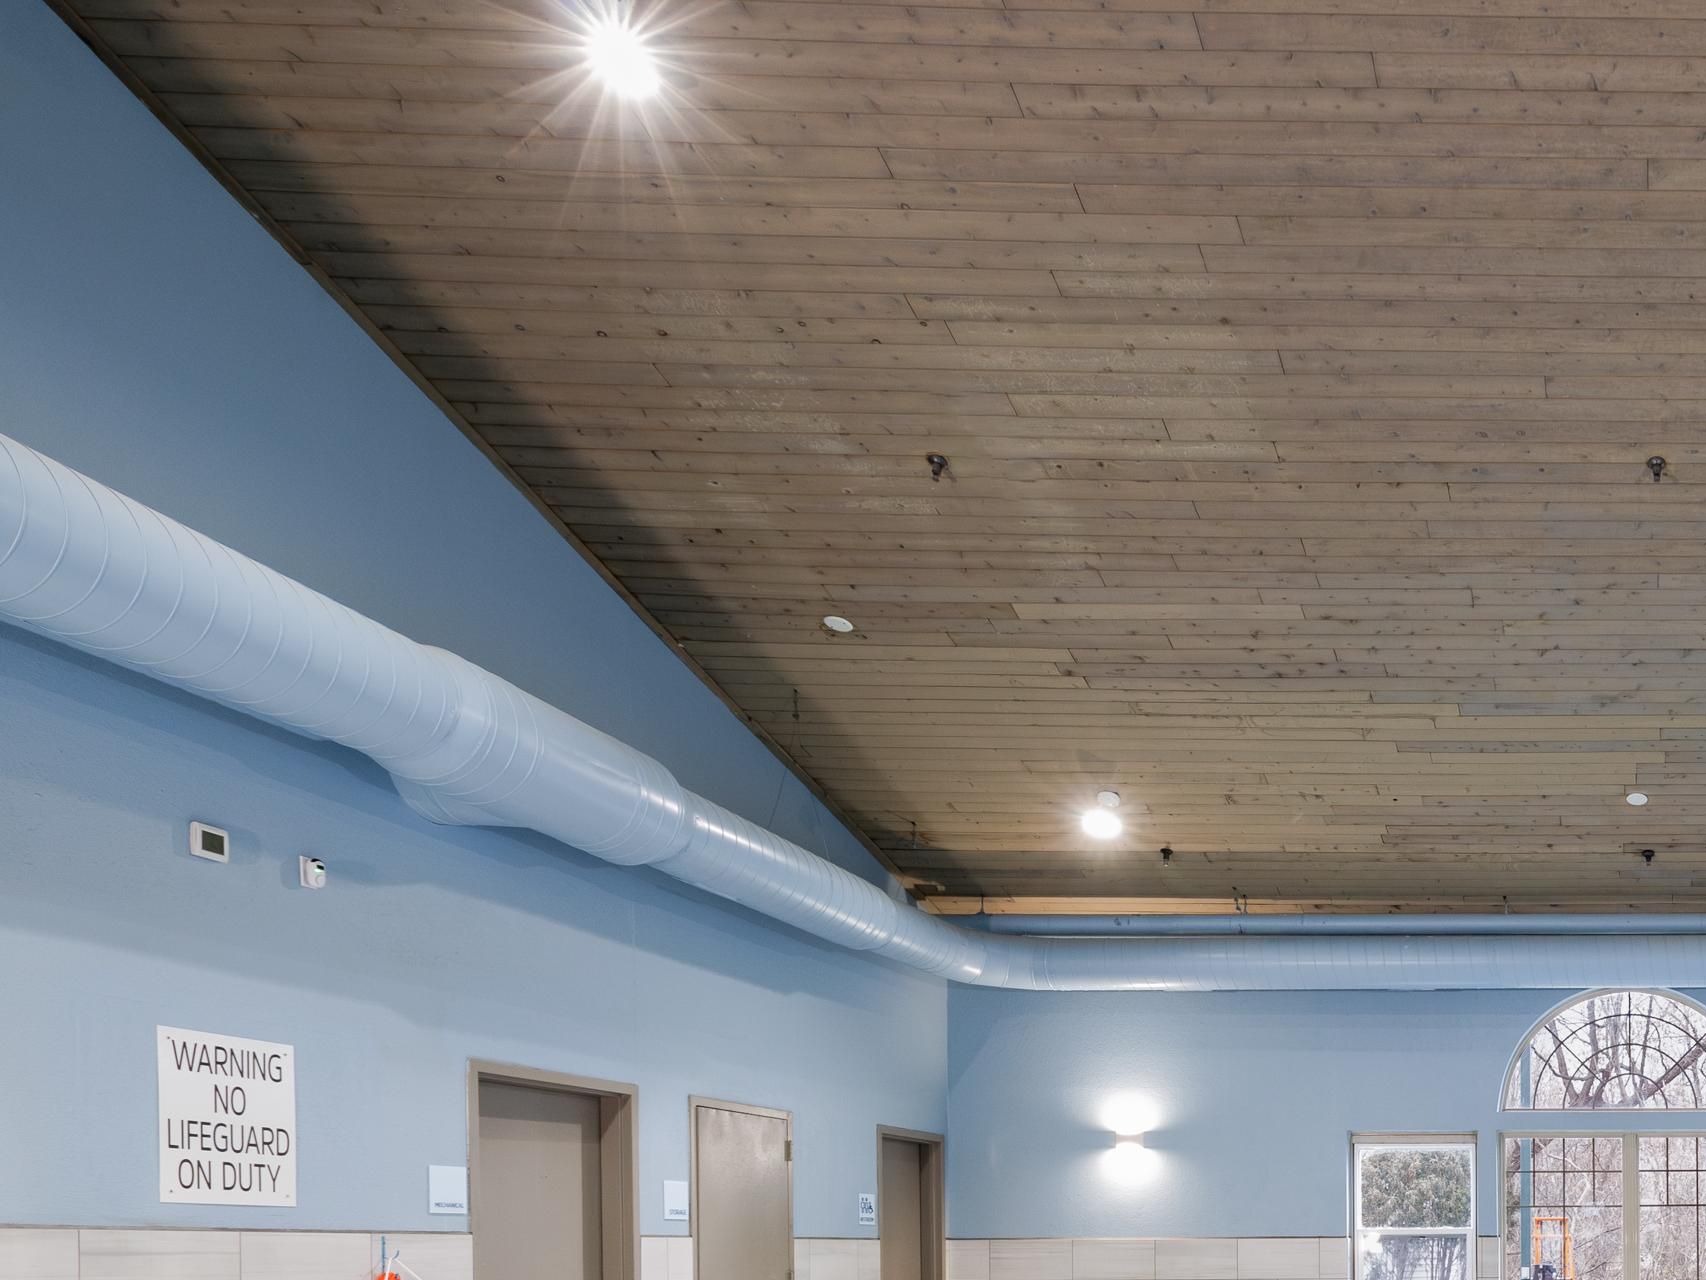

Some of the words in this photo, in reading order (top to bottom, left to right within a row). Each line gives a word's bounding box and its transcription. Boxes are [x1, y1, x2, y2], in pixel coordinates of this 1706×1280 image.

[171, 1040, 282, 1083] WARNING
[214, 1084, 246, 1116] NO
[167, 1118, 290, 1156] LIFEGUARD
[178, 1158, 212, 1190] ON
[222, 1161, 281, 1192] DUTY
